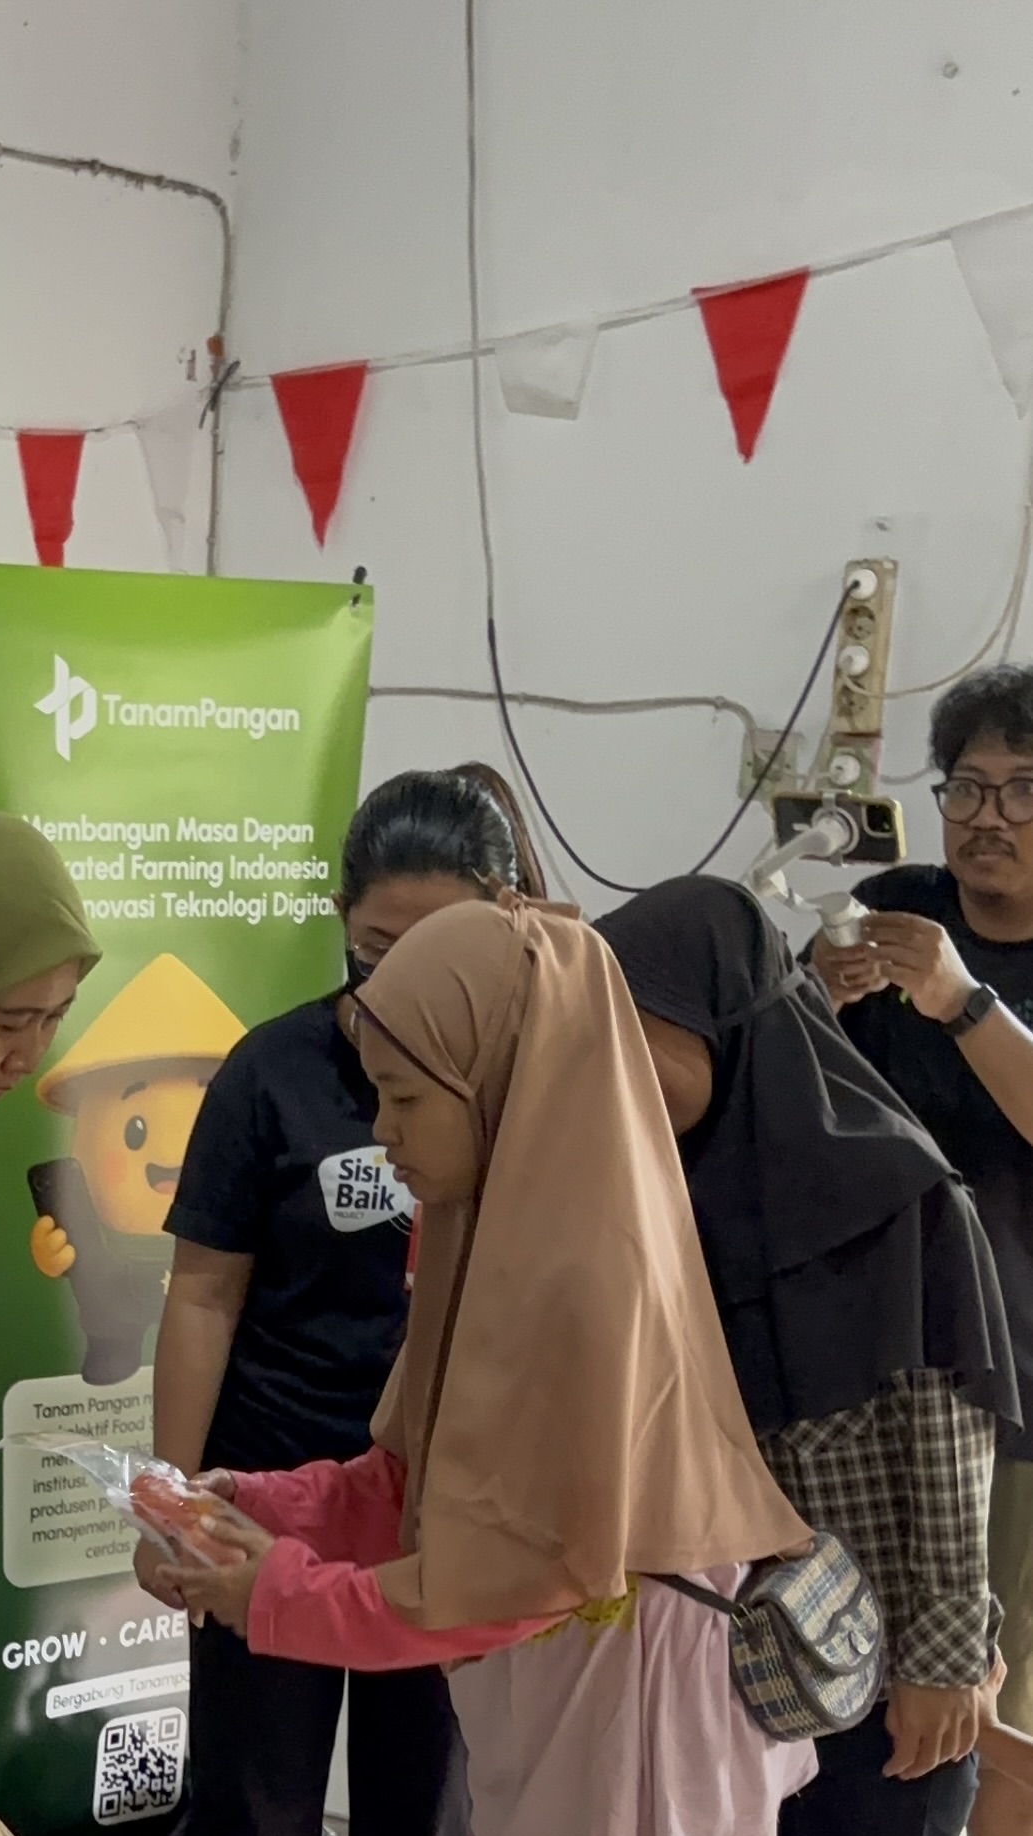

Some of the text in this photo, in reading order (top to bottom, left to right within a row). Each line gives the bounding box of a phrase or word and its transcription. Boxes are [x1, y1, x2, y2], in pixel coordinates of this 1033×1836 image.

[103, 694, 300, 739] TanamPangan
[176, 816, 238, 844] Masa
[243, 817, 314, 850] Depan
[65, 853, 329, 888] ated Farming Indonesia
[161, 892, 267, 925] Teknologi
[338, 1158, 381, 1184] Sisi
[335, 1183, 396, 1212] Baik
[33, 1402, 85, 1419] Tanam
[88, 1395, 140, 1415] Pangan
[112, 1418, 146, 1435] Food
[30, 1498, 96, 1524] produsen
[32, 1519, 117, 1543] manajemen
[85, 1539, 131, 1559] cerdas
[2, 1610, 186, 1670] GROW CARE
[53, 1685, 124, 1710] Bergabung
